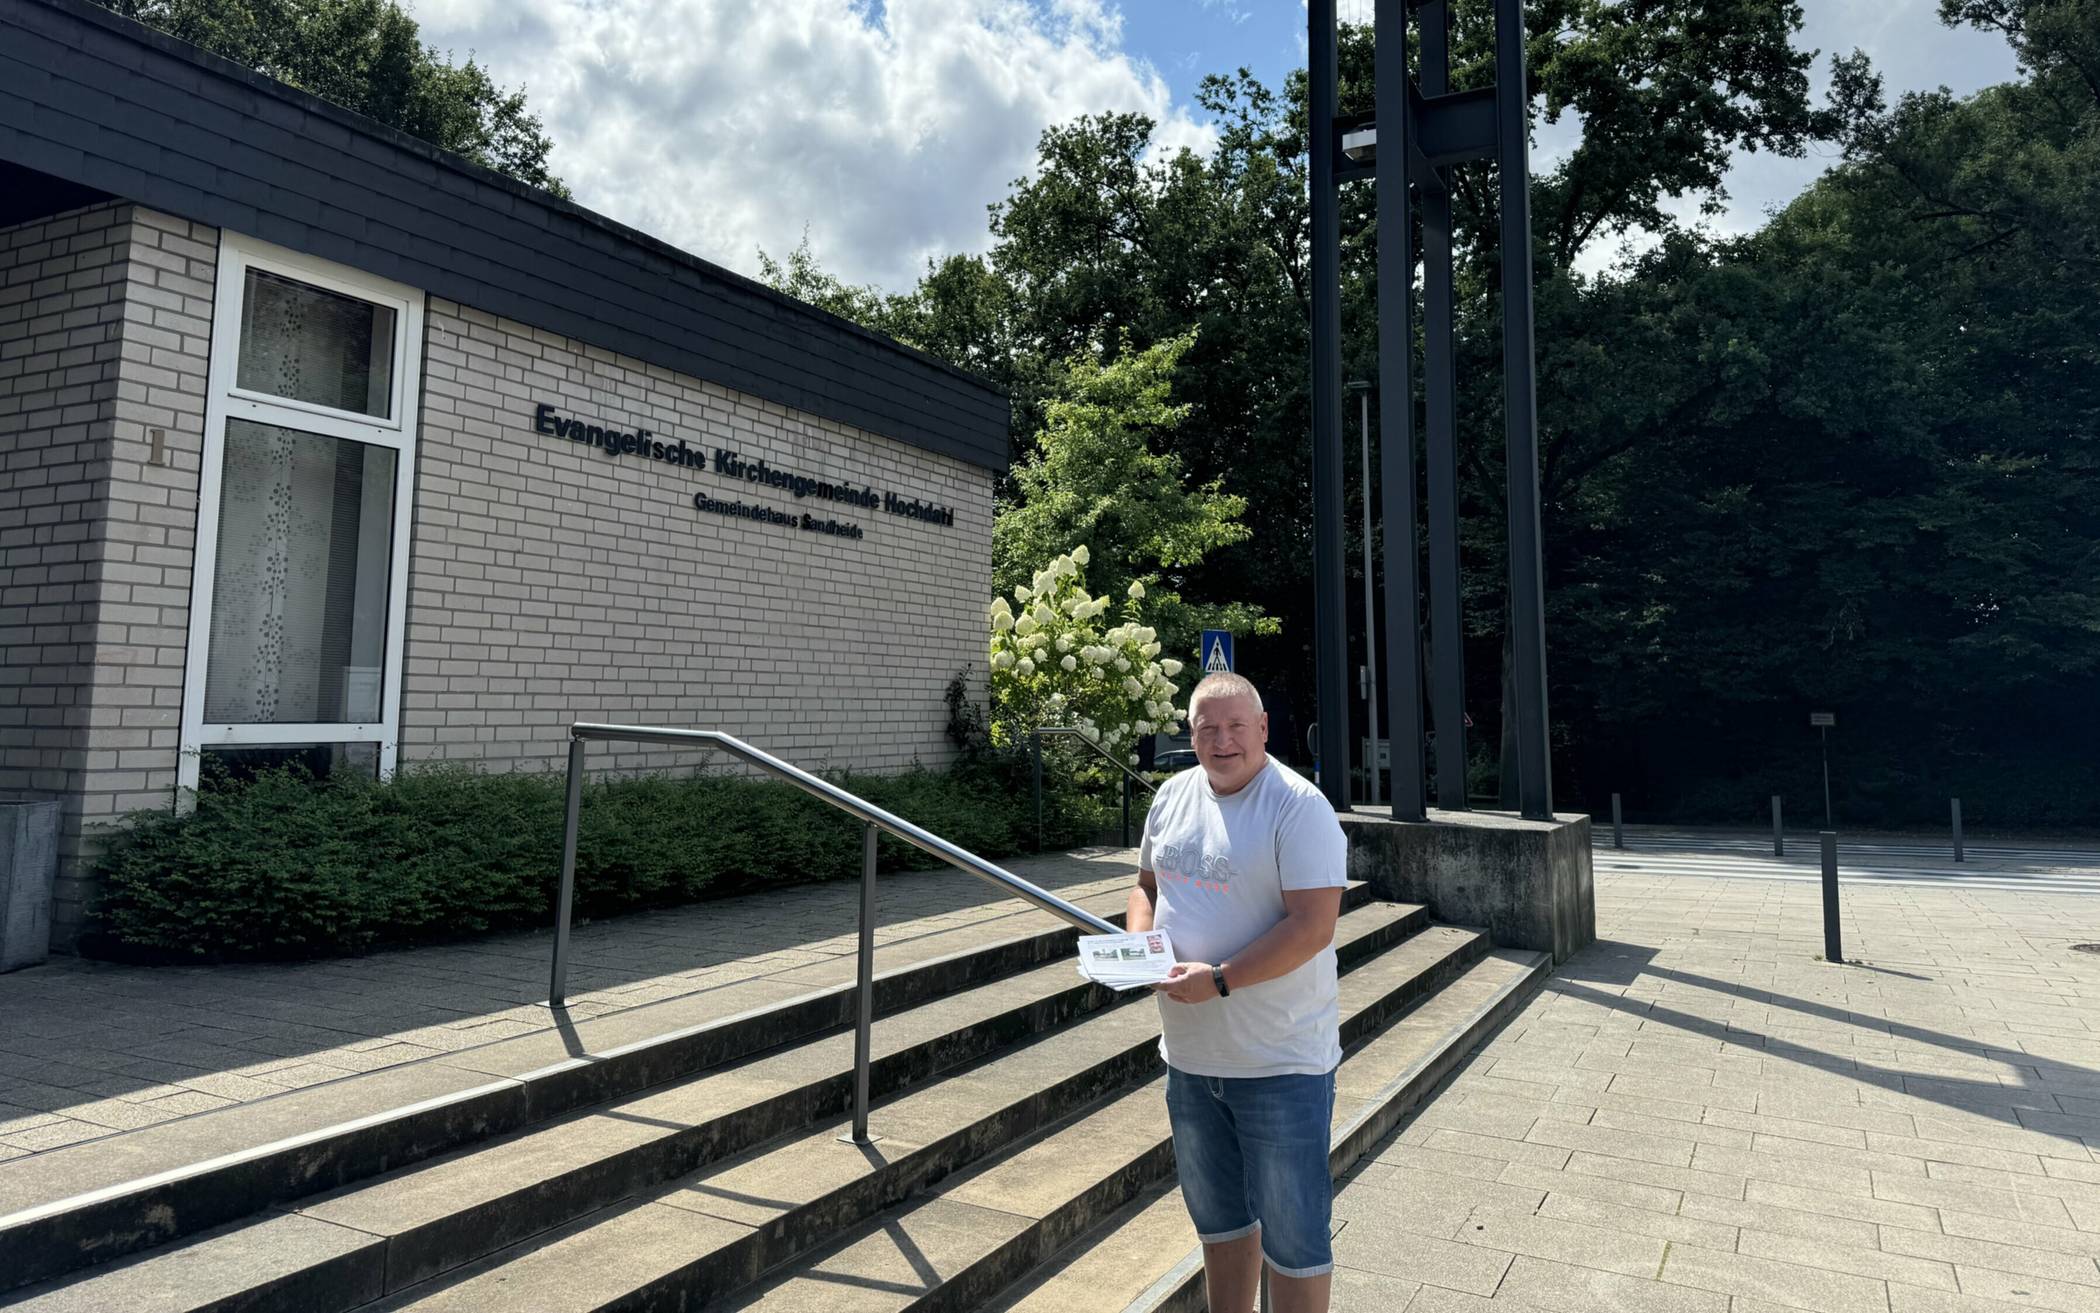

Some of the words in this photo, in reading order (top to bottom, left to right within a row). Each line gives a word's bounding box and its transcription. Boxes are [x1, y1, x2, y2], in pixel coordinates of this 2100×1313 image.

[536, 404, 706, 470] Evangelische
[715, 449, 880, 510] Kirchengemeinde
[884, 491, 954, 527] Hochdahl
[695, 492, 798, 528] Gemeindehaus
[801, 514, 863, 540] Sandheide
